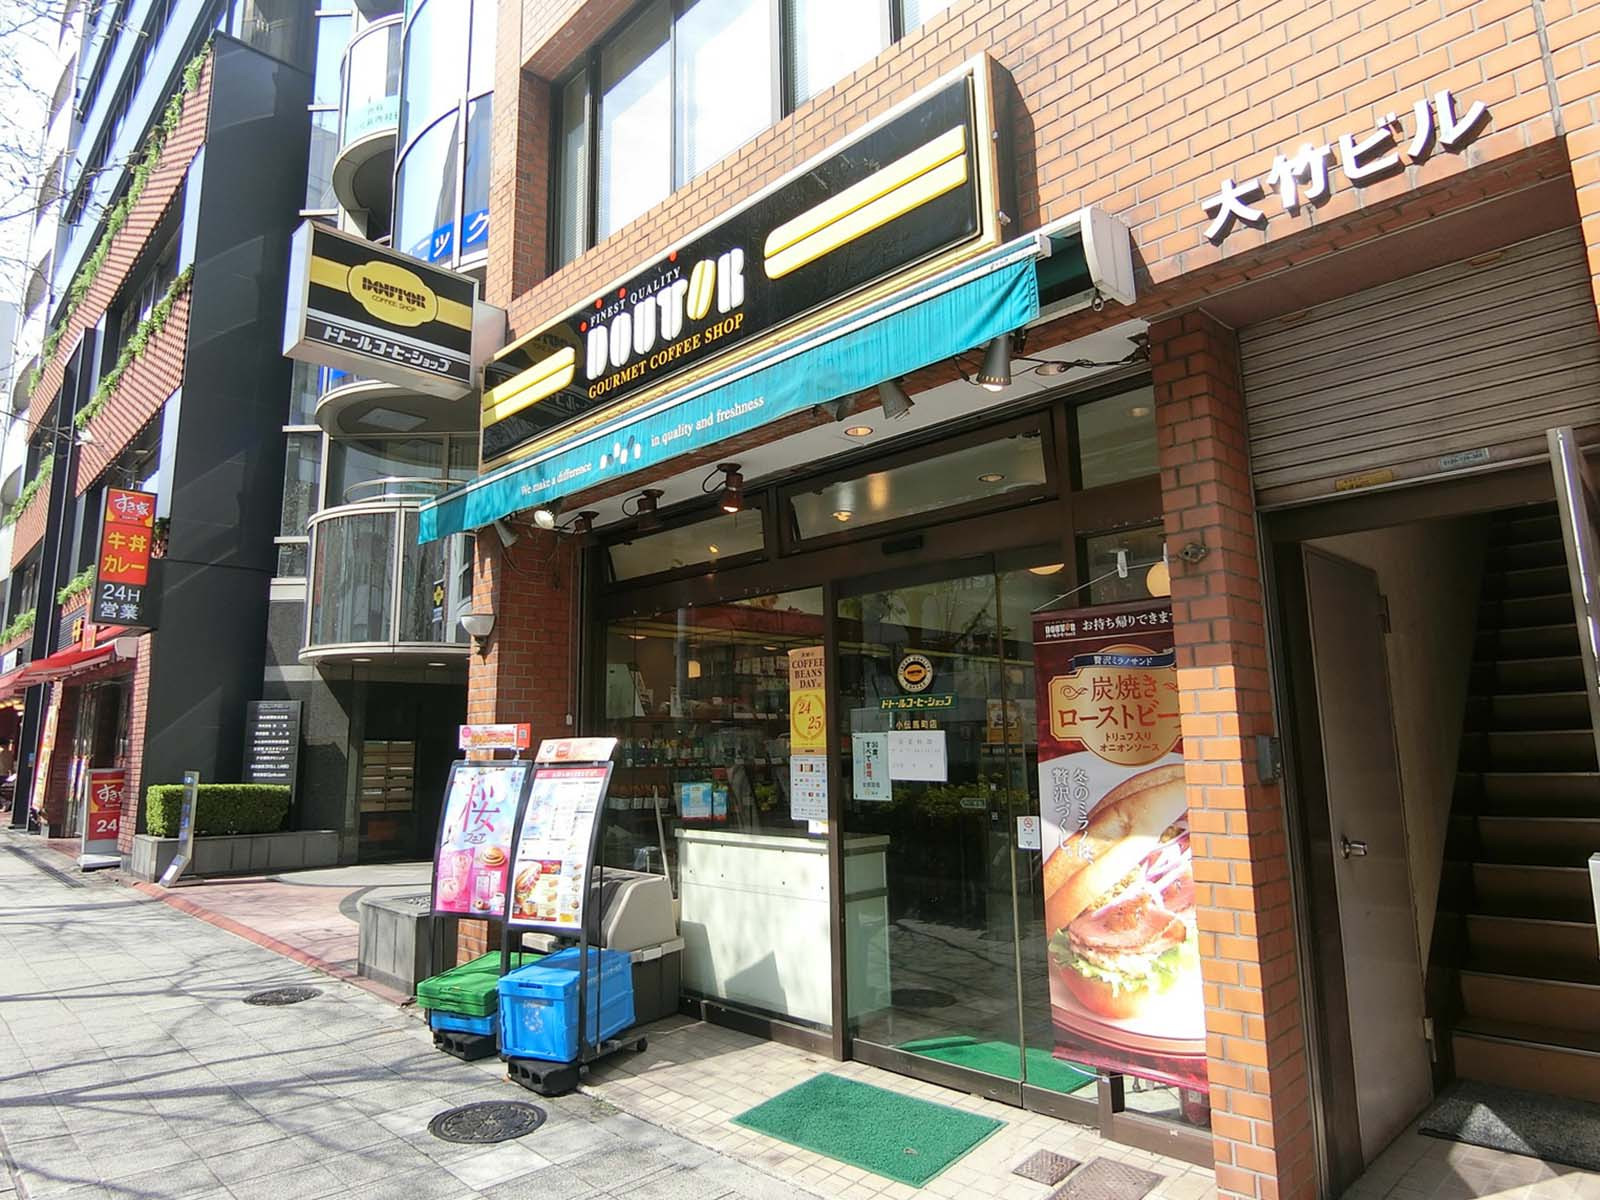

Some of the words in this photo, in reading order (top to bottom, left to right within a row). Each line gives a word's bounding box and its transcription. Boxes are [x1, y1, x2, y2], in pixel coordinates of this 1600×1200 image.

[1201, 89, 1491, 243] 大竹ビル
[362, 276, 426, 309] DOUTOR
[590, 299, 627, 328] FINEST
[630, 266, 681, 304] QUALITY
[586, 247, 745, 381] DOUTOR
[323, 326, 452, 372] ドトールコーヒーショップ
[588, 361, 647, 400] GOURMET
[650, 334, 701, 370] COFFEE
[704, 313, 744, 344] SHOP
[651, 435, 660, 447] in
[662, 421, 693, 448] quality
[696, 412, 714, 433] and
[716, 396, 765, 424] freshness
[108, 531, 147, 553] 牛丼
[103, 553, 145, 573] カレー
[102, 583, 140, 602] 24H
[101, 601, 139, 620] 営業
[792, 658, 824, 669] COFFEE
[794, 668, 822, 679] BEANS
[800, 679, 817, 689] DAY
[1091, 674, 1159, 702] 炭焼き
[799, 701, 812, 715] 24
[1058, 701, 1181, 729] ローストビー
[808, 715, 822, 730] 25
[1105, 732, 1152, 741] トリュフ入り
[1100, 742, 1160, 752] オニオンソース
[97, 784, 122, 802] すき
